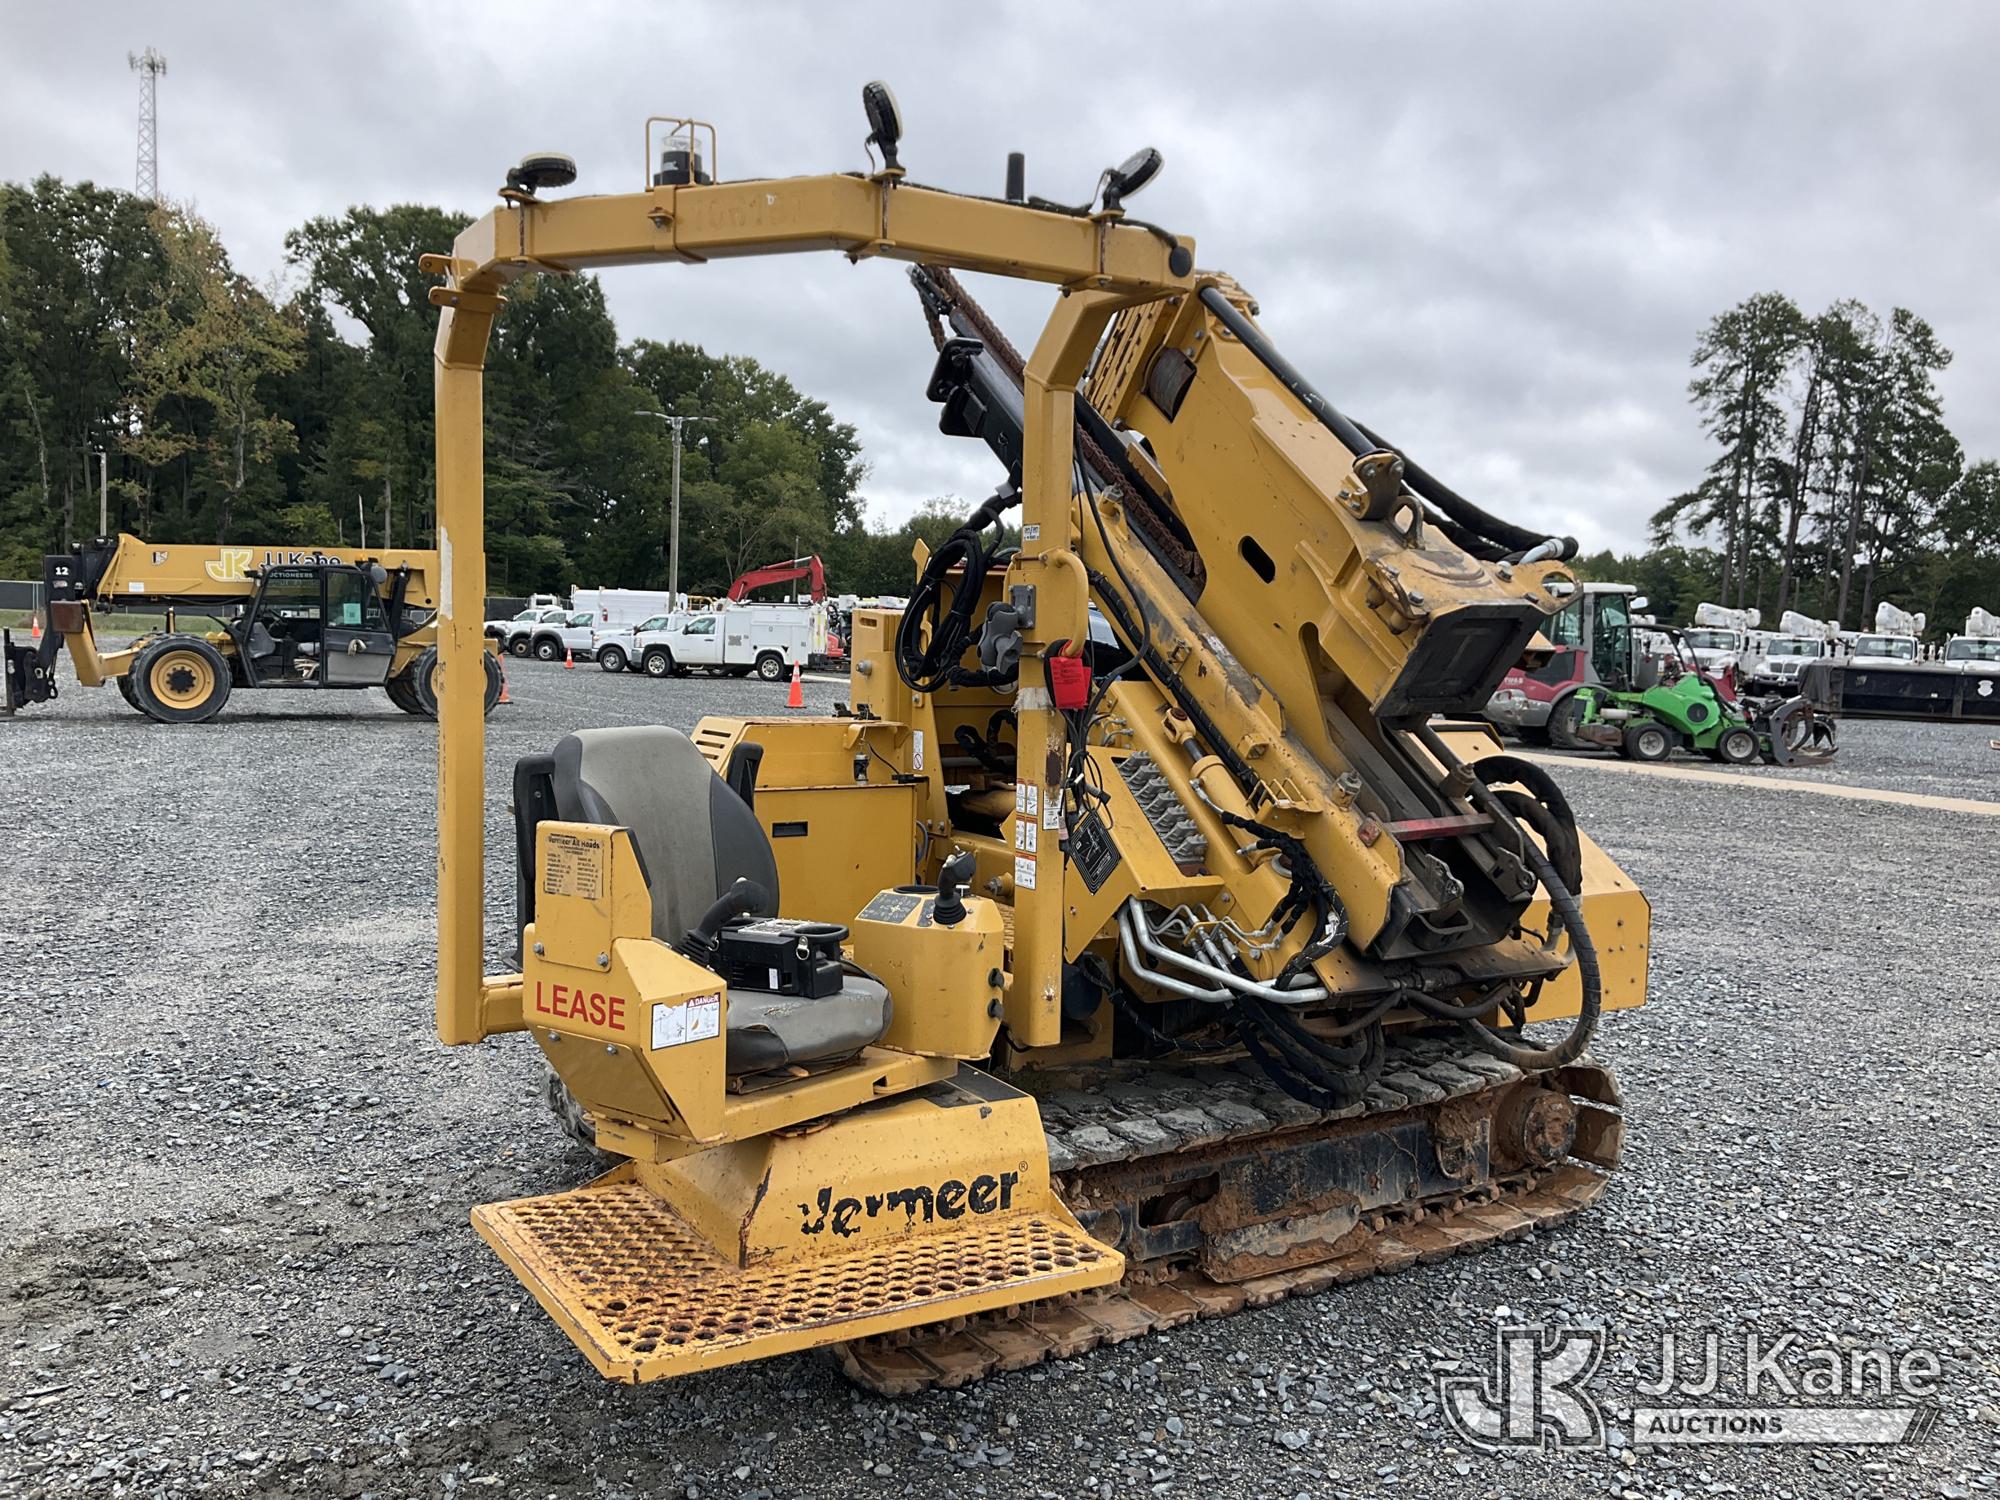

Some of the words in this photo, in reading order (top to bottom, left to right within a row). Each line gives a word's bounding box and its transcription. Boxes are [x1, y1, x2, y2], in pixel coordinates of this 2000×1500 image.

[55, 566, 69, 576] 12
[536, 980, 625, 1031] LEASE
[694, 994, 719, 1007] DANGER
